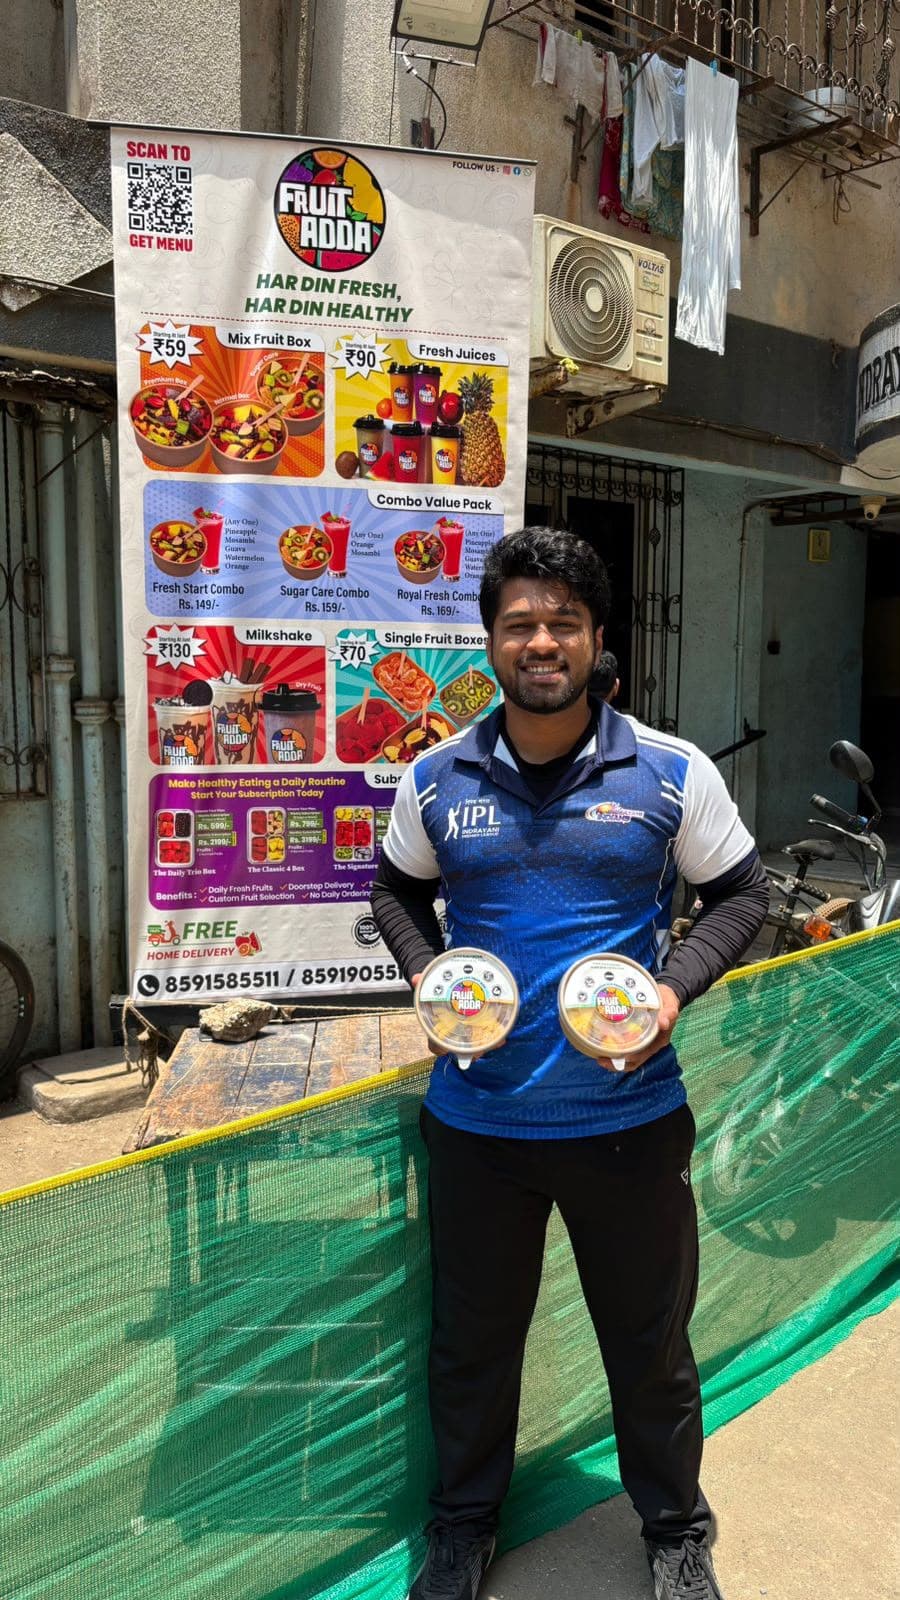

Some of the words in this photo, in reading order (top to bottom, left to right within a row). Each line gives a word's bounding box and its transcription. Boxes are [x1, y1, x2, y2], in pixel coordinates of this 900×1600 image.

[126, 141, 168, 160] SCAN
[171, 145, 191, 162] TO
[452, 161, 484, 172] FOLLOW
[485, 164, 495, 172] US
[278, 182, 354, 219] FRUIT
[300, 216, 372, 253] ADDA
[130, 234, 154, 249] GET
[156, 237, 193, 252] MENU
[638, 259, 665, 274] VOLTAS
[256, 274, 298, 291] HAR
[300, 276, 337, 293] DIN
[338, 278, 402, 302] FRESH,
[244, 298, 286, 314] HAR
[288, 300, 326, 318] DIN
[327, 302, 414, 323] HEALTHY
[228, 332, 250, 345] Mix
[254, 334, 284, 346] Fruit
[287, 336, 311, 348] Box
[153, 338, 186, 357] ₹59
[419, 344, 454, 357] Fresh
[456, 347, 496, 362] Juices
[346, 349, 376, 368] ₹90
[144, 377, 174, 386] Premium
[377, 494, 422, 507] Combo
[425, 496, 460, 508] Value
[463, 499, 492, 510] Pack
[225, 528, 257, 536] Pineapple
[351, 541, 374, 550] Orange
[225, 554, 264, 562] Watermelon
[225, 563, 250, 571] Orange
[153, 582, 180, 594] Fresh
[183, 583, 208, 594] Start
[210, 584, 245, 595] Combo
[280, 586, 309, 598] Sugar
[312, 586, 334, 597] Care
[336, 588, 369, 598] Combo
[398, 589, 422, 601] Royal
[424, 590, 449, 600] Fresh
[179, 599, 194, 610] Rs.
[196, 599, 219, 610] 149/-
[305, 602, 320, 612] Rs.
[322, 602, 345, 613] 159/-
[421, 605, 434, 616] Rs.
[437, 606, 460, 616] 169/-
[246, 629, 312, 641] Milkshake
[385, 632, 422, 646] Single
[424, 633, 452, 645] Fruit
[159, 643, 191, 658] ₹130
[340, 646, 366, 661] ₹70
[217, 723, 240, 734] FRUIT
[164, 746, 187, 756] FRUIT
[272, 740, 295, 751] FRUIT
[168, 779, 196, 788] Make
[198, 778, 237, 789] Healthy
[240, 778, 271, 788] Eating
[281, 777, 306, 788] Daily
[308, 777, 346, 785] Routine
[191, 791, 214, 799] Start
[238, 790, 294, 799] Subscription
[296, 789, 324, 798] Today
[463, 805, 501, 828] IPL
[168, 869, 185, 877] Daily
[208, 886, 228, 894] Daily
[289, 882, 323, 891] Doorstep
[324, 881, 355, 890] Delivery
[156, 891, 193, 900] Benefits
[322, 891, 340, 899] Daily
[182, 921, 238, 940] FREE
[147, 950, 180, 961] HOME
[183, 948, 234, 959] DELIVERY
[165, 970, 279, 993] 8591585511
[286, 969, 295, 987] /
[301, 965, 403, 985] 859190551
